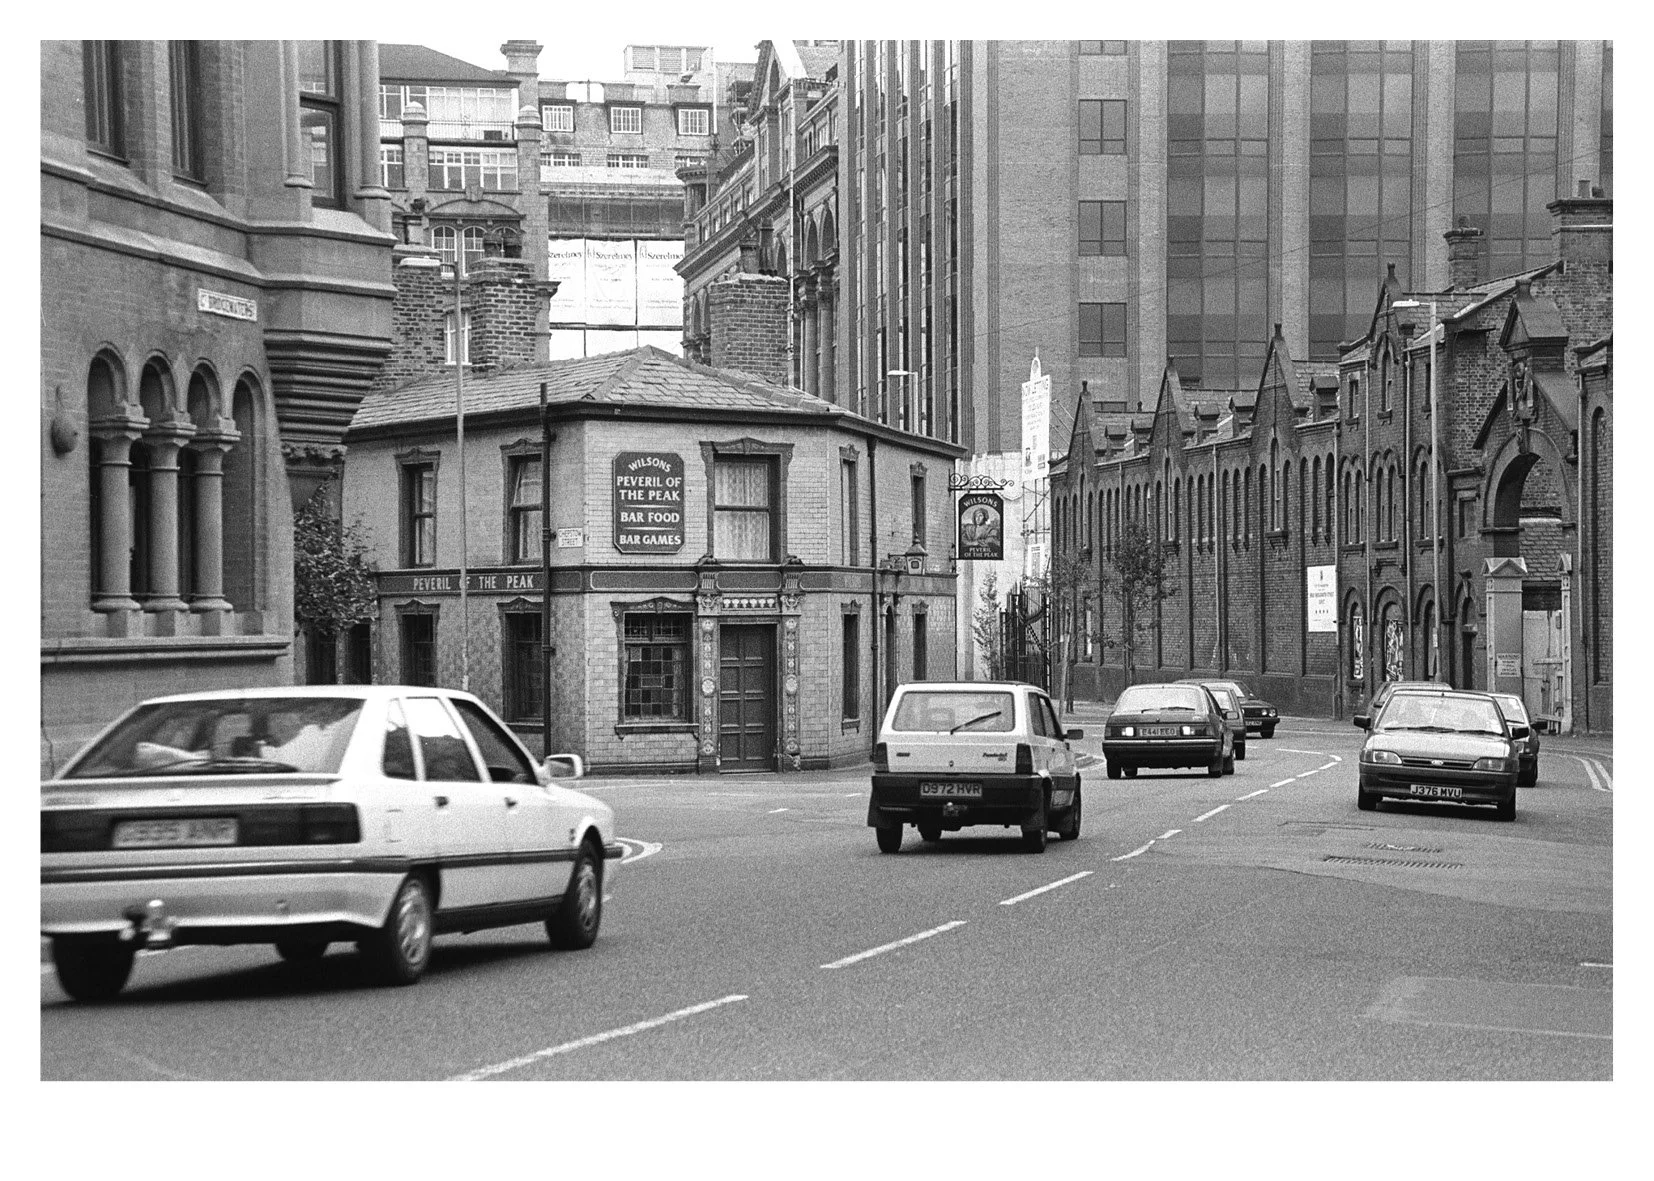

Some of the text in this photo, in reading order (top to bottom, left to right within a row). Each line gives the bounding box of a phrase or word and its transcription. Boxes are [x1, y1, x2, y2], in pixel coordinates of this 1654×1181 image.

[628, 457, 672, 473] WILSONS
[616, 476, 682, 488] PEVERIL OF
[619, 489, 680, 501] THE PEAK
[963, 496, 998, 508] WILSONS
[620, 512, 680, 523] BAR FOOD
[619, 534, 682, 545] BAR GAMES
[413, 577, 451, 591] PEVERIL
[479, 576, 497, 589] THE
[507, 575, 534, 589] PEAK
[921, 783, 981, 795] D972 HVR
[1411, 785, 1462, 798] J376 MVU
